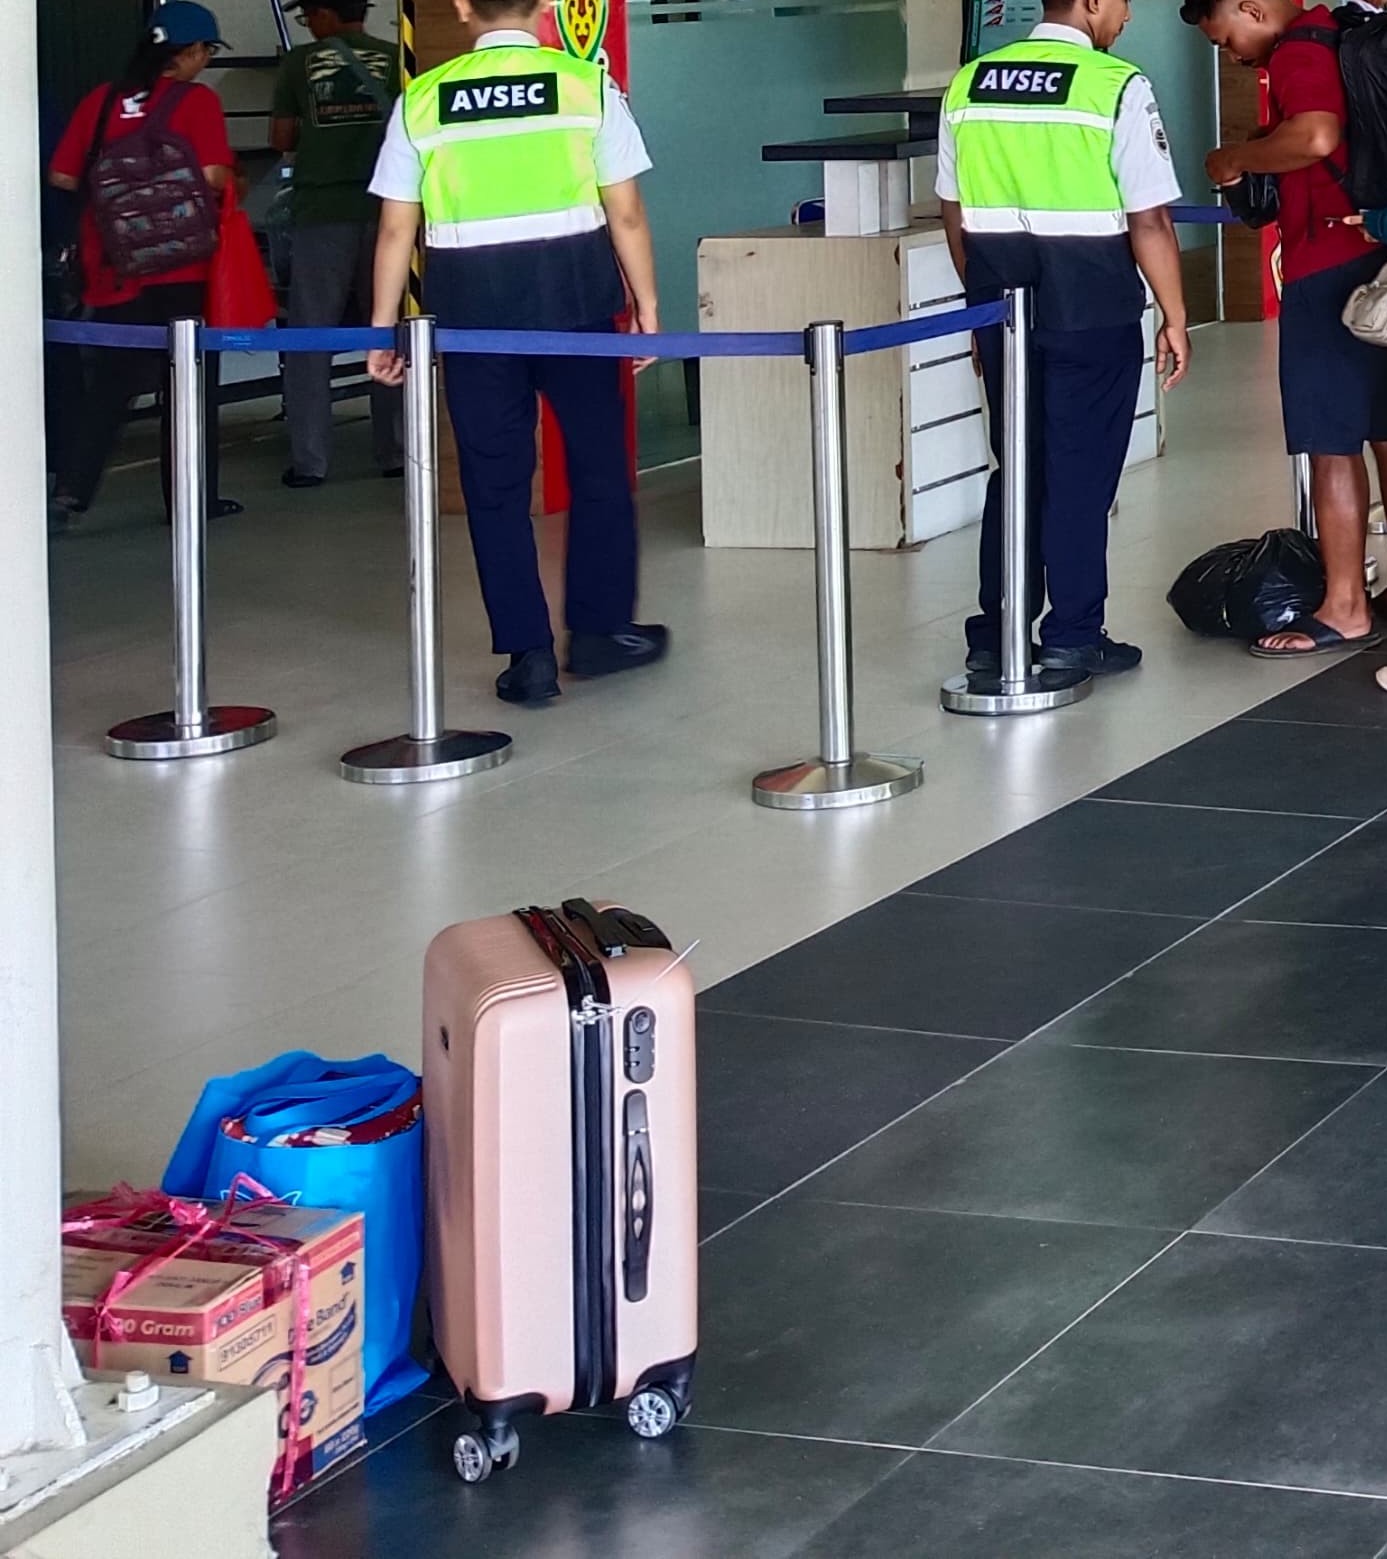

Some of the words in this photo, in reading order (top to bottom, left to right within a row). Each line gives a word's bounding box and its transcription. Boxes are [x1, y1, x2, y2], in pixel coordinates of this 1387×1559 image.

[978, 68, 1063, 93] AVSEC
[450, 82, 545, 112] AVSEC
[140, 1319, 195, 1337] Gram
